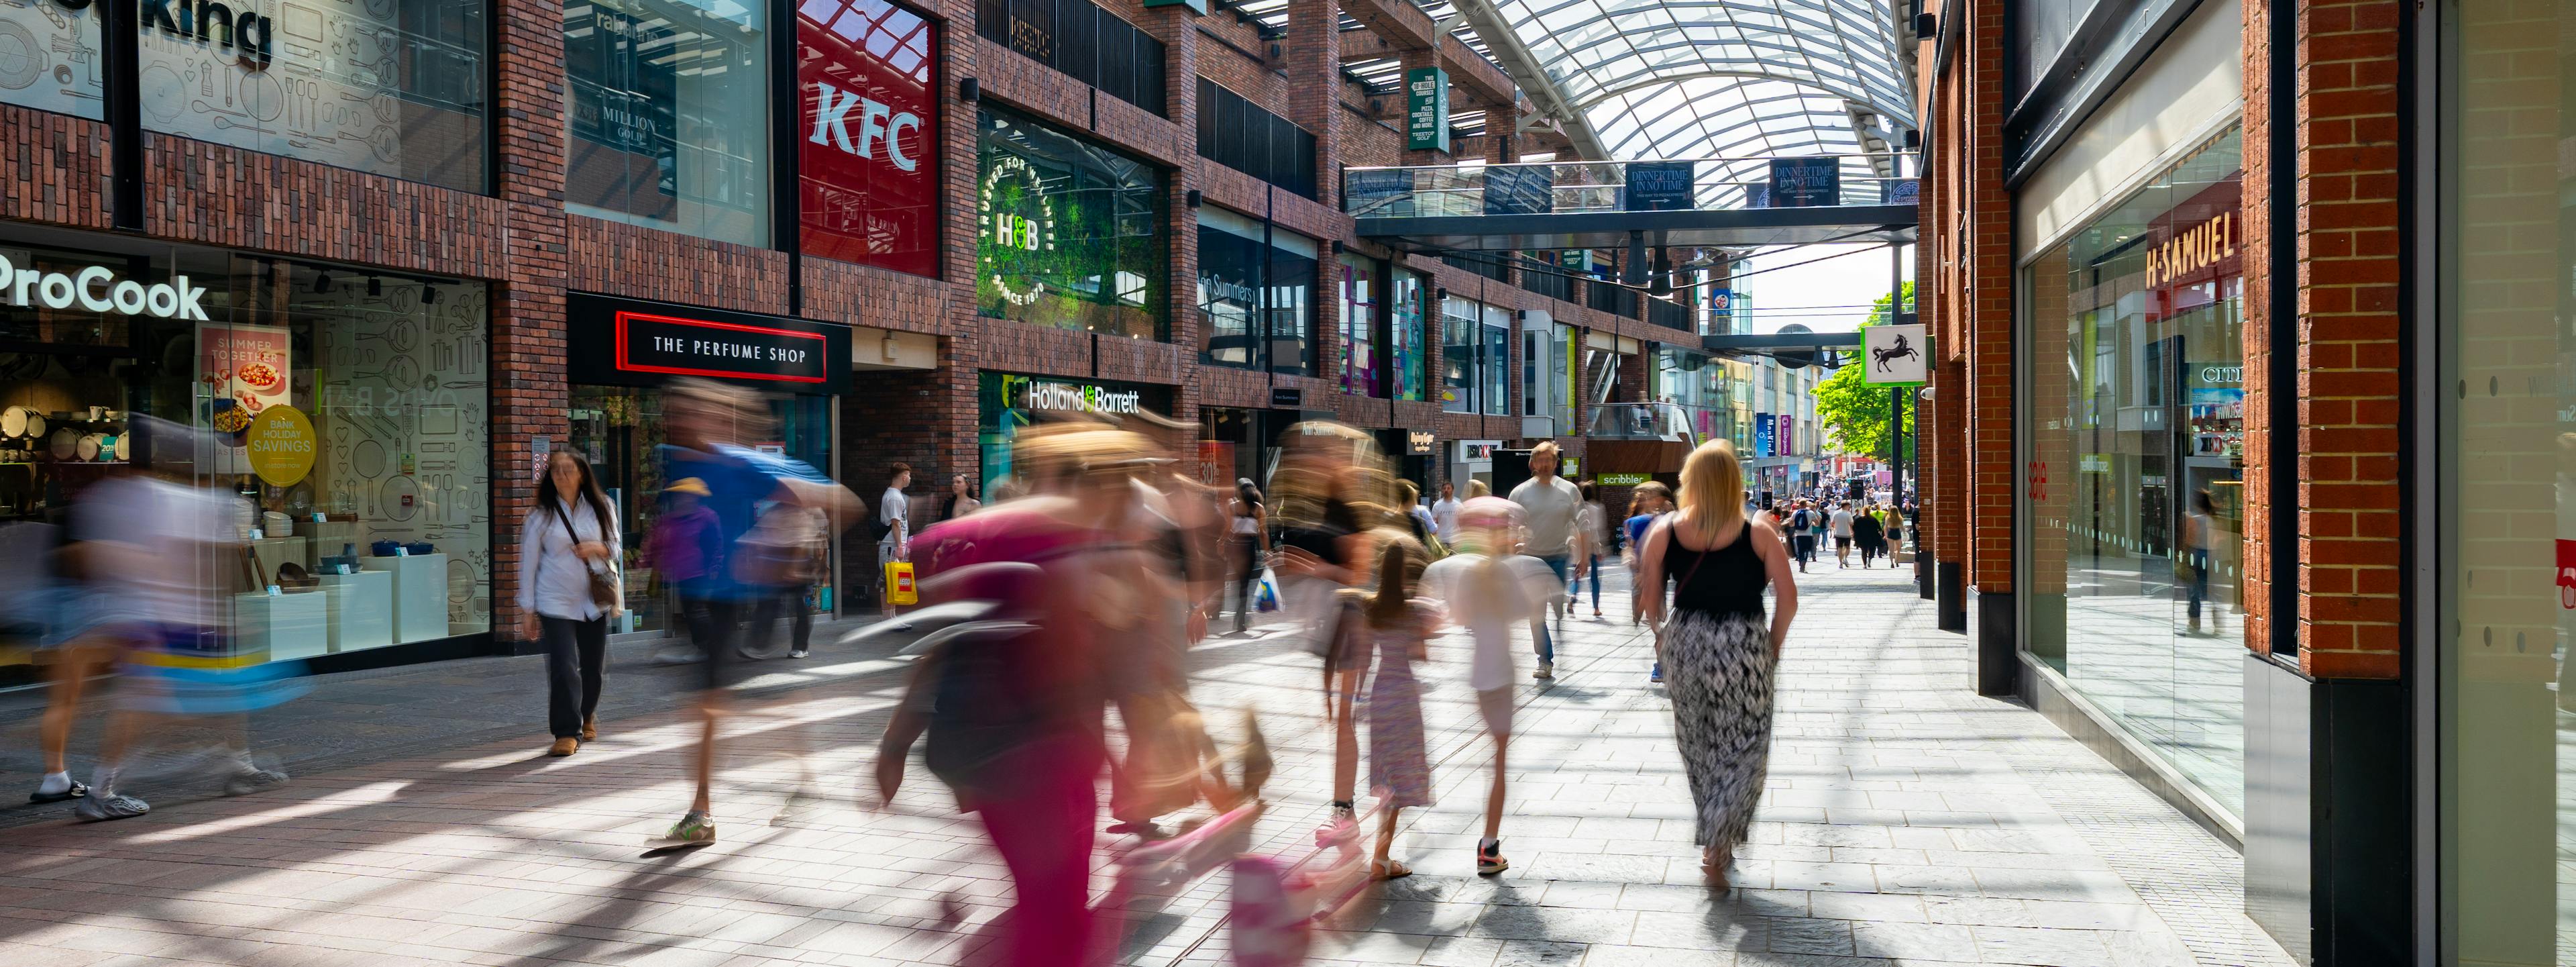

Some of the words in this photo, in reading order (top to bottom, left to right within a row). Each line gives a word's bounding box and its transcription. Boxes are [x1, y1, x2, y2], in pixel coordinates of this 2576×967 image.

[1413, 81, 1434, 90] 18-HOLE
[603, 106, 655, 132] MILLION
[809, 81, 920, 172] KFC
[617, 127, 642, 142] GOLD
[1632, 170, 1688, 181] DINNERTIME
[1776, 165, 1833, 178] DINNERTIME
[1636, 181, 1647, 191] IN
[1647, 181, 1660, 191] NO
[1662, 180, 1684, 191] TIME
[1780, 177, 1790, 188] IN
[1791, 176, 1804, 187] NO
[1806, 176, 1829, 187] TIME
[979, 164, 1004, 238] TRUSTED
[1006, 157, 1025, 170] FOR
[1029, 166, 1054, 251] WELLNESS
[996, 213, 1038, 251] H&B
[992, 274, 1022, 306] SINCE
[1024, 283, 1044, 305] 1870
[1214, 273, 1252, 303] Summers
[218, 338, 272, 350] SUMMER
[654, 336, 684, 353] THE
[694, 340, 761, 359] PERFUME
[769, 347, 806, 363] SHOP
[211, 349, 278, 363] TOGETHER
[270, 420, 294, 429] BANK
[1302, 421, 1313, 436] Ann
[1313, 422, 1336, 436] Summers
[263, 429, 301, 440] HOLIDAY
[254, 440, 311, 452] SAVINGS
[2028, 443, 2047, 501] sale
[1604, 474, 1644, 485] scribbler
[899, 577, 911, 586] LEGO
